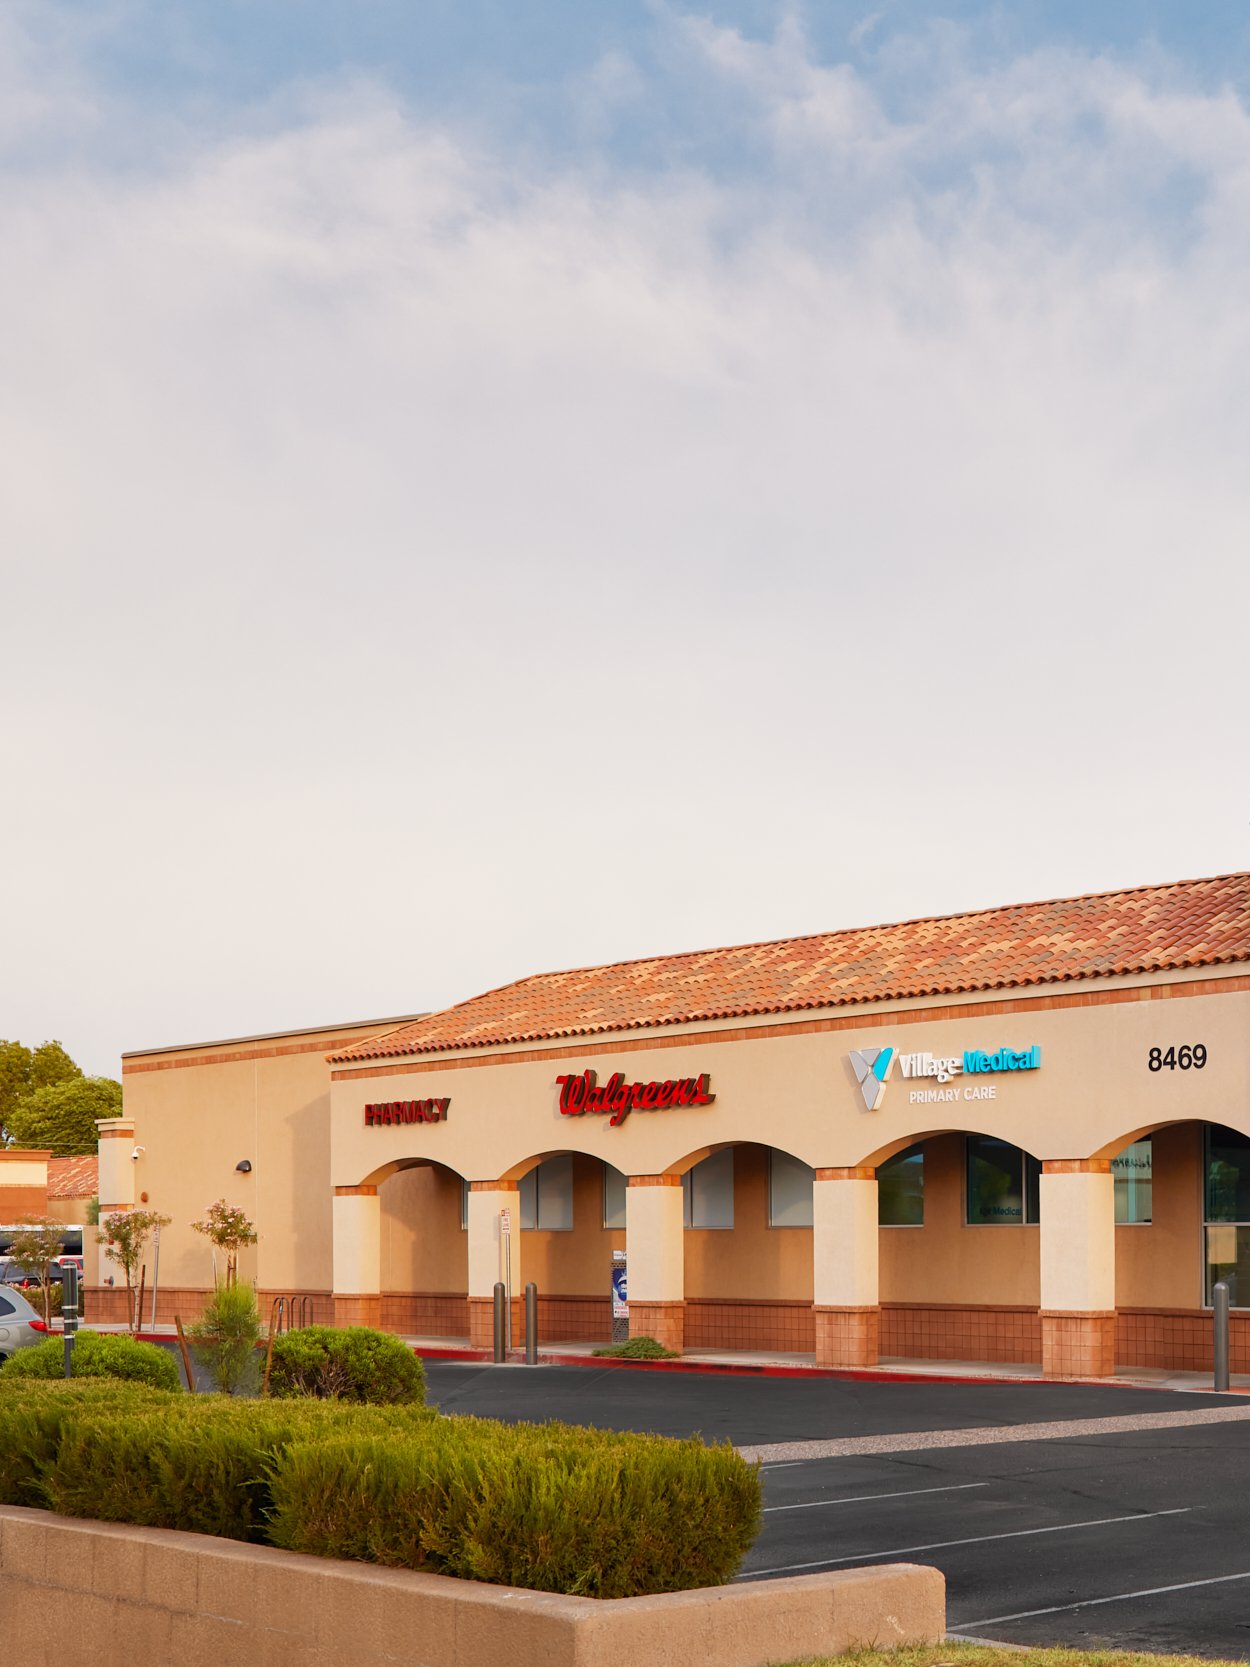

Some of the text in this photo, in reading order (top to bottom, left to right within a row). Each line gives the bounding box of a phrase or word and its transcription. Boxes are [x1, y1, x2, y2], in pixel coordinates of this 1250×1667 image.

[899, 1046, 1041, 1083] Village Medical
[1148, 1043, 1207, 1072] 8469
[556, 1069, 716, 1127] Walgreens
[909, 1086, 997, 1104] PRIMARY CARE
[364, 1097, 452, 1127] PHARMACY
